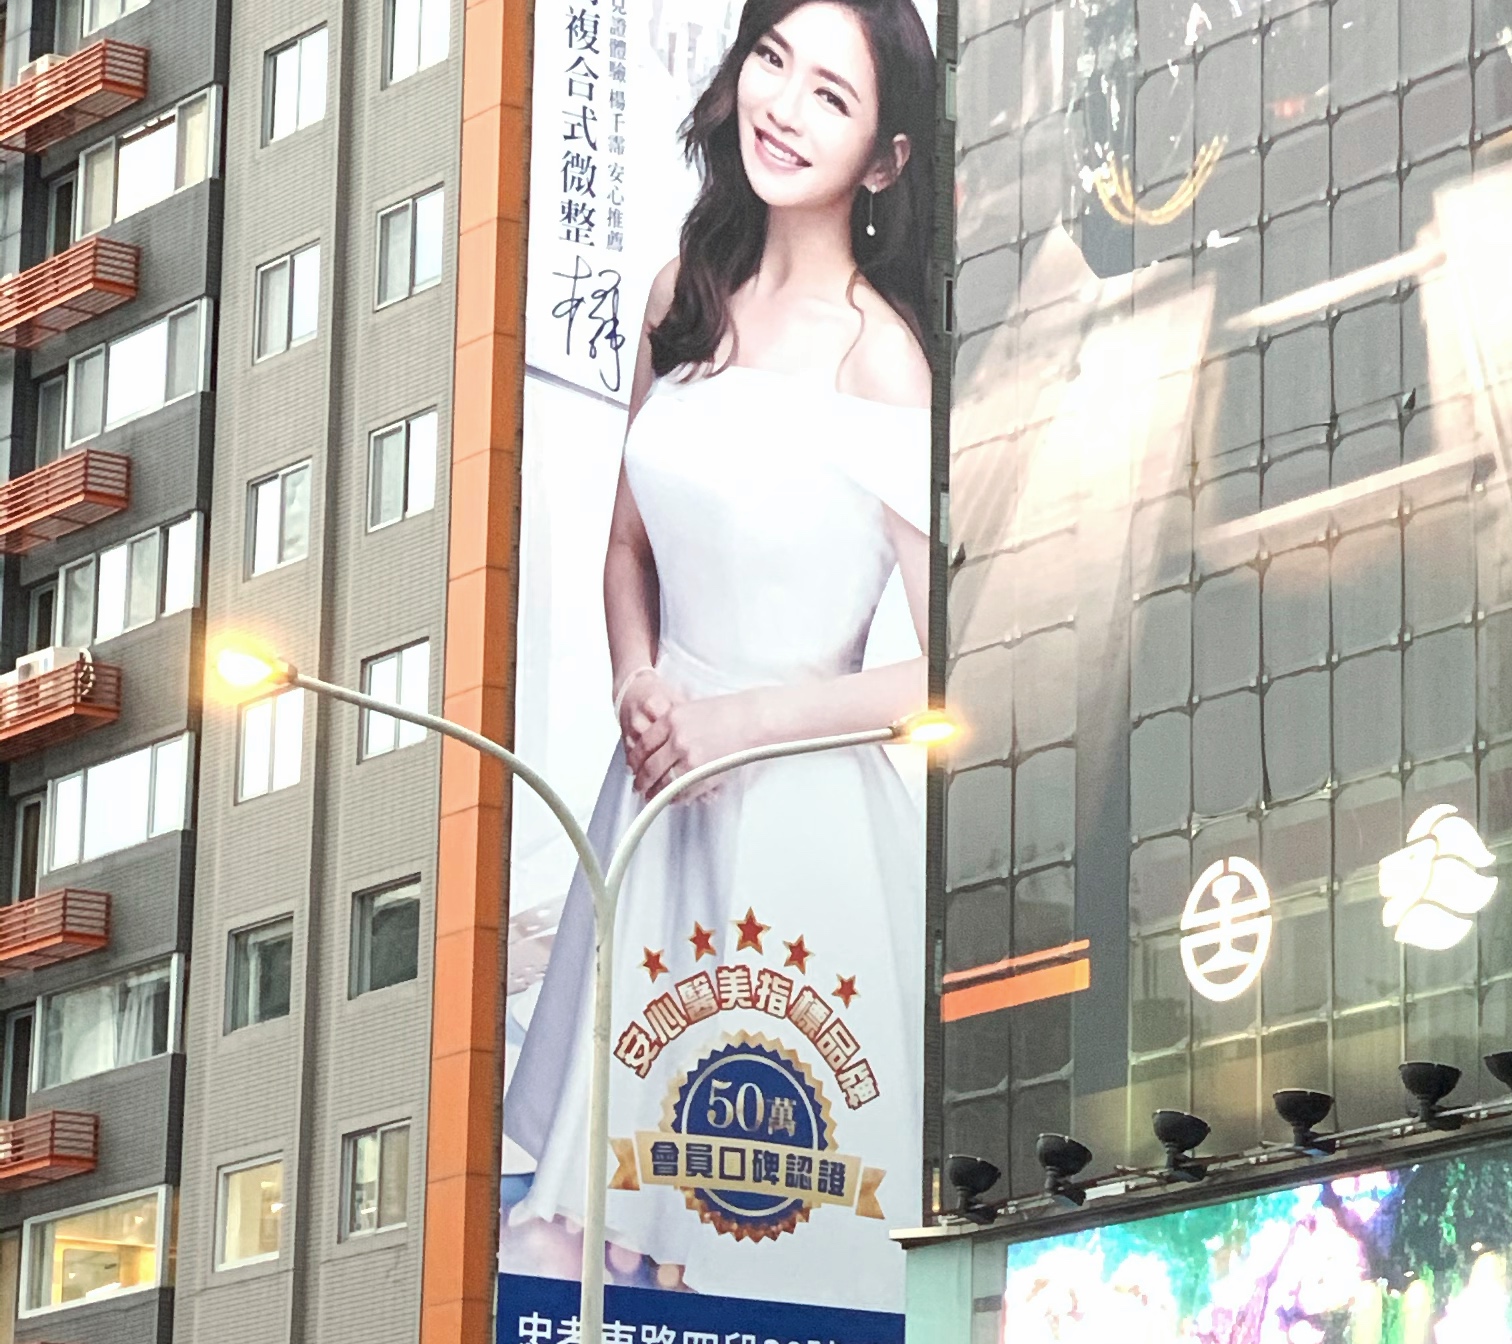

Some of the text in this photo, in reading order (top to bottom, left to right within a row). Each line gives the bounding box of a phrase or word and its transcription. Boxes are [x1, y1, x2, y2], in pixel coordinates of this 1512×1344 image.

[613, 965, 880, 1111] 安心醫美指標品牌
[706, 1078, 797, 1137] 50萬
[650, 1141, 847, 1198] 會員口碑認證
